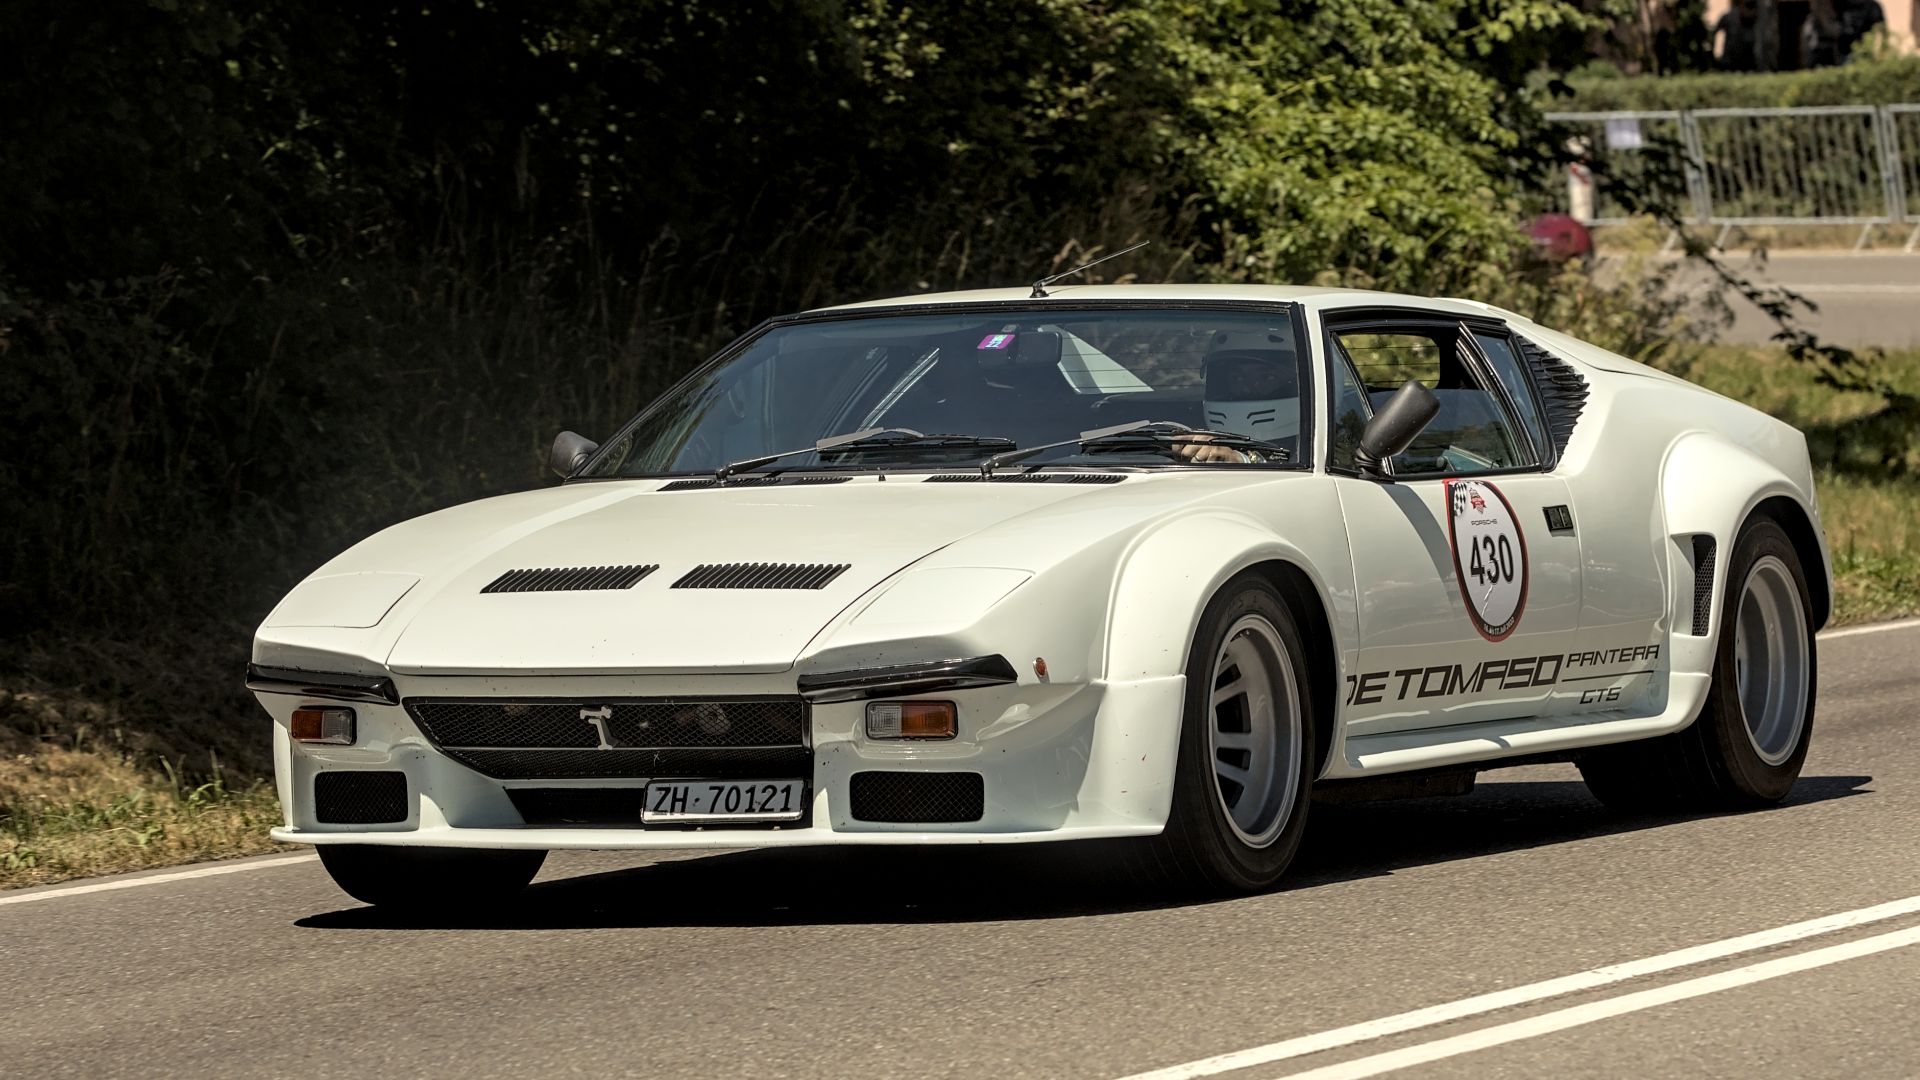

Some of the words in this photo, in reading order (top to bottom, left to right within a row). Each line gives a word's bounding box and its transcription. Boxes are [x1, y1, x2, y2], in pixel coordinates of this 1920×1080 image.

[1470, 534, 1514, 585] 430
[1566, 644, 1660, 668] PANTERA
[1579, 687, 1622, 705] GTS
